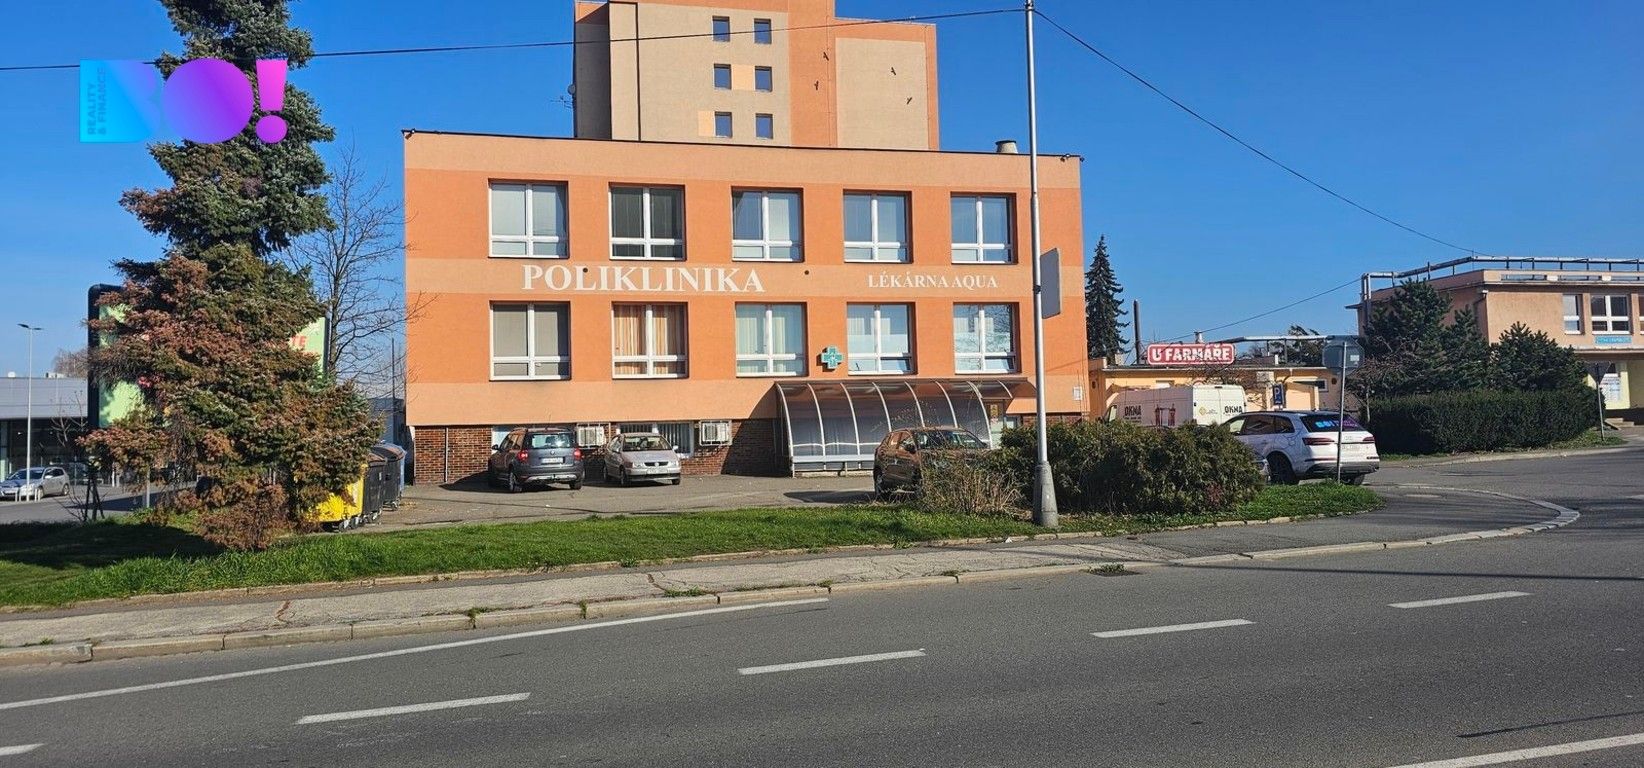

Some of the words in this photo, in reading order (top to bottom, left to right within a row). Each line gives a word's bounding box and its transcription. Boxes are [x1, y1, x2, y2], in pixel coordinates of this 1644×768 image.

[521, 264, 766, 293] POLIKLINIKA
[868, 271, 948, 288] LÉKÁRNA
[951, 275, 999, 290] AQUA
[1152, 348, 1162, 361] U
[1165, 344, 1230, 361] FARMÁŘE
[1124, 405, 1142, 416] OKNA
[1224, 405, 1243, 413] OKNA
